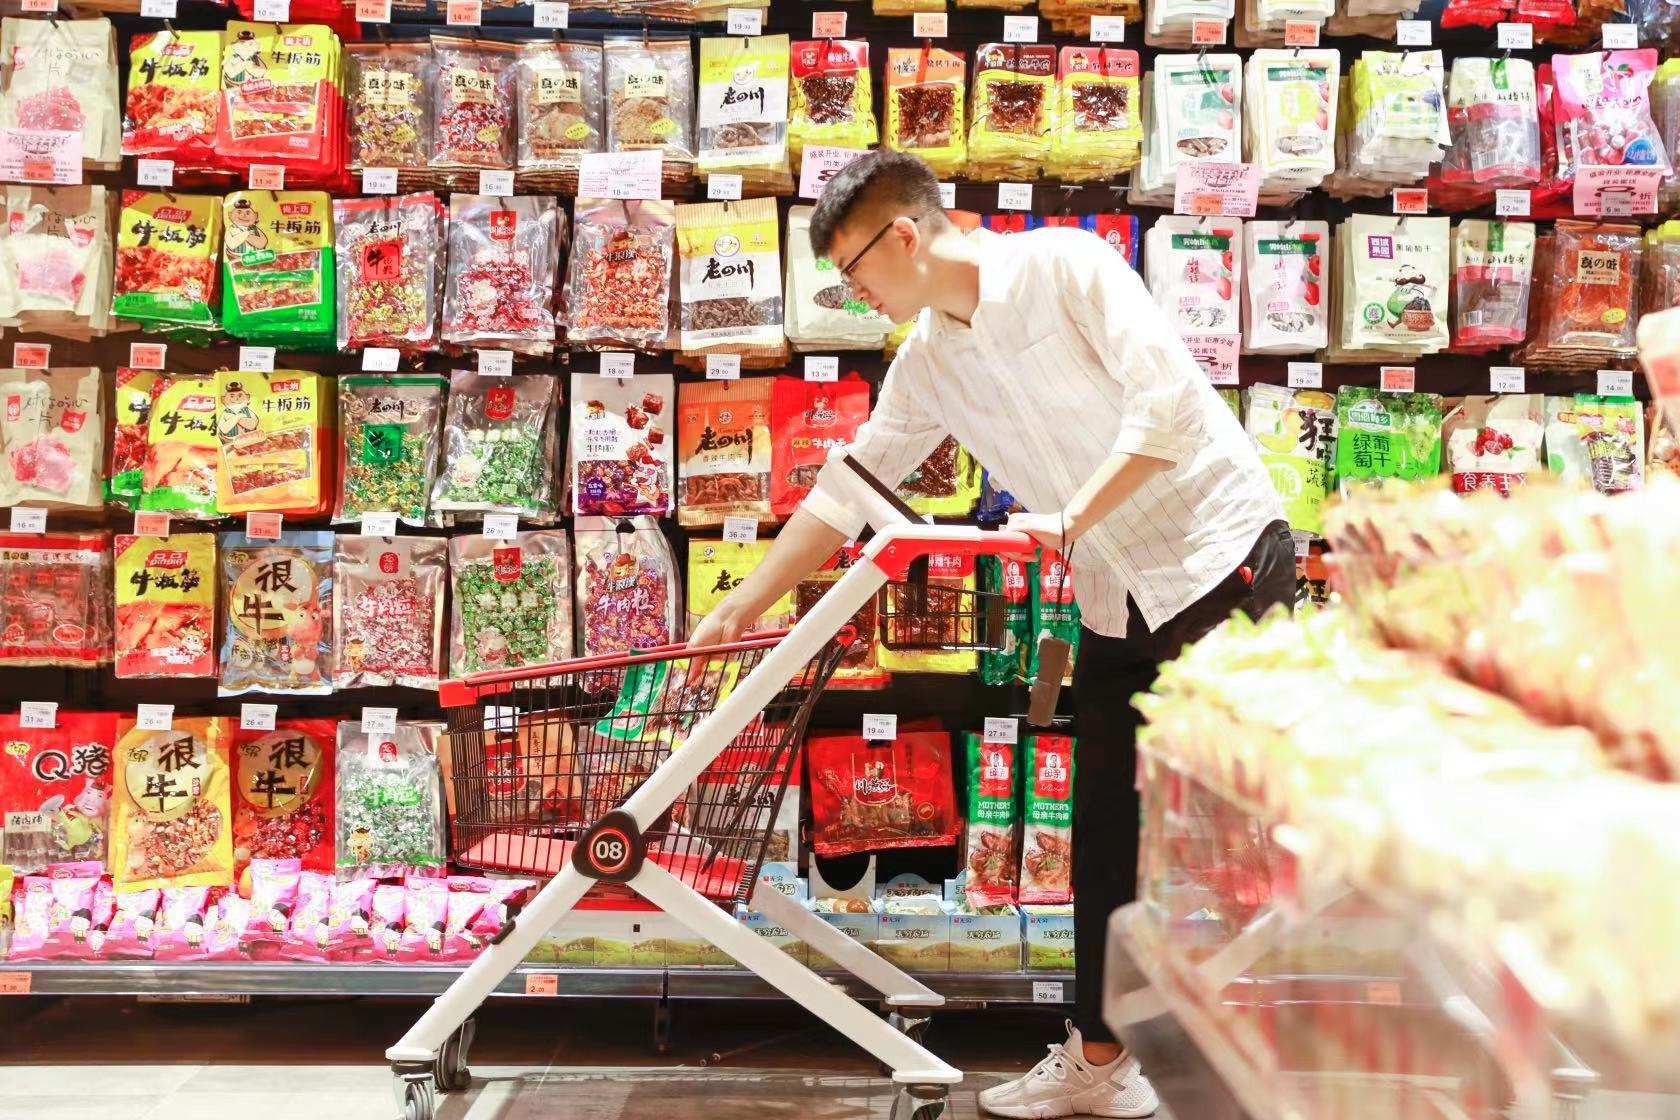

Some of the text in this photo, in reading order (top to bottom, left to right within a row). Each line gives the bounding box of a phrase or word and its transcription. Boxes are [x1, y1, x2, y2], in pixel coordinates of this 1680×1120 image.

[272, 51, 321, 66] 牛板筋
[270, 219, 321, 235] 牛板筋
[262, 396, 311, 413] 牛板筋
[1353, 433, 1391, 452] 绿葡
[595, 840, 622, 860] 08
